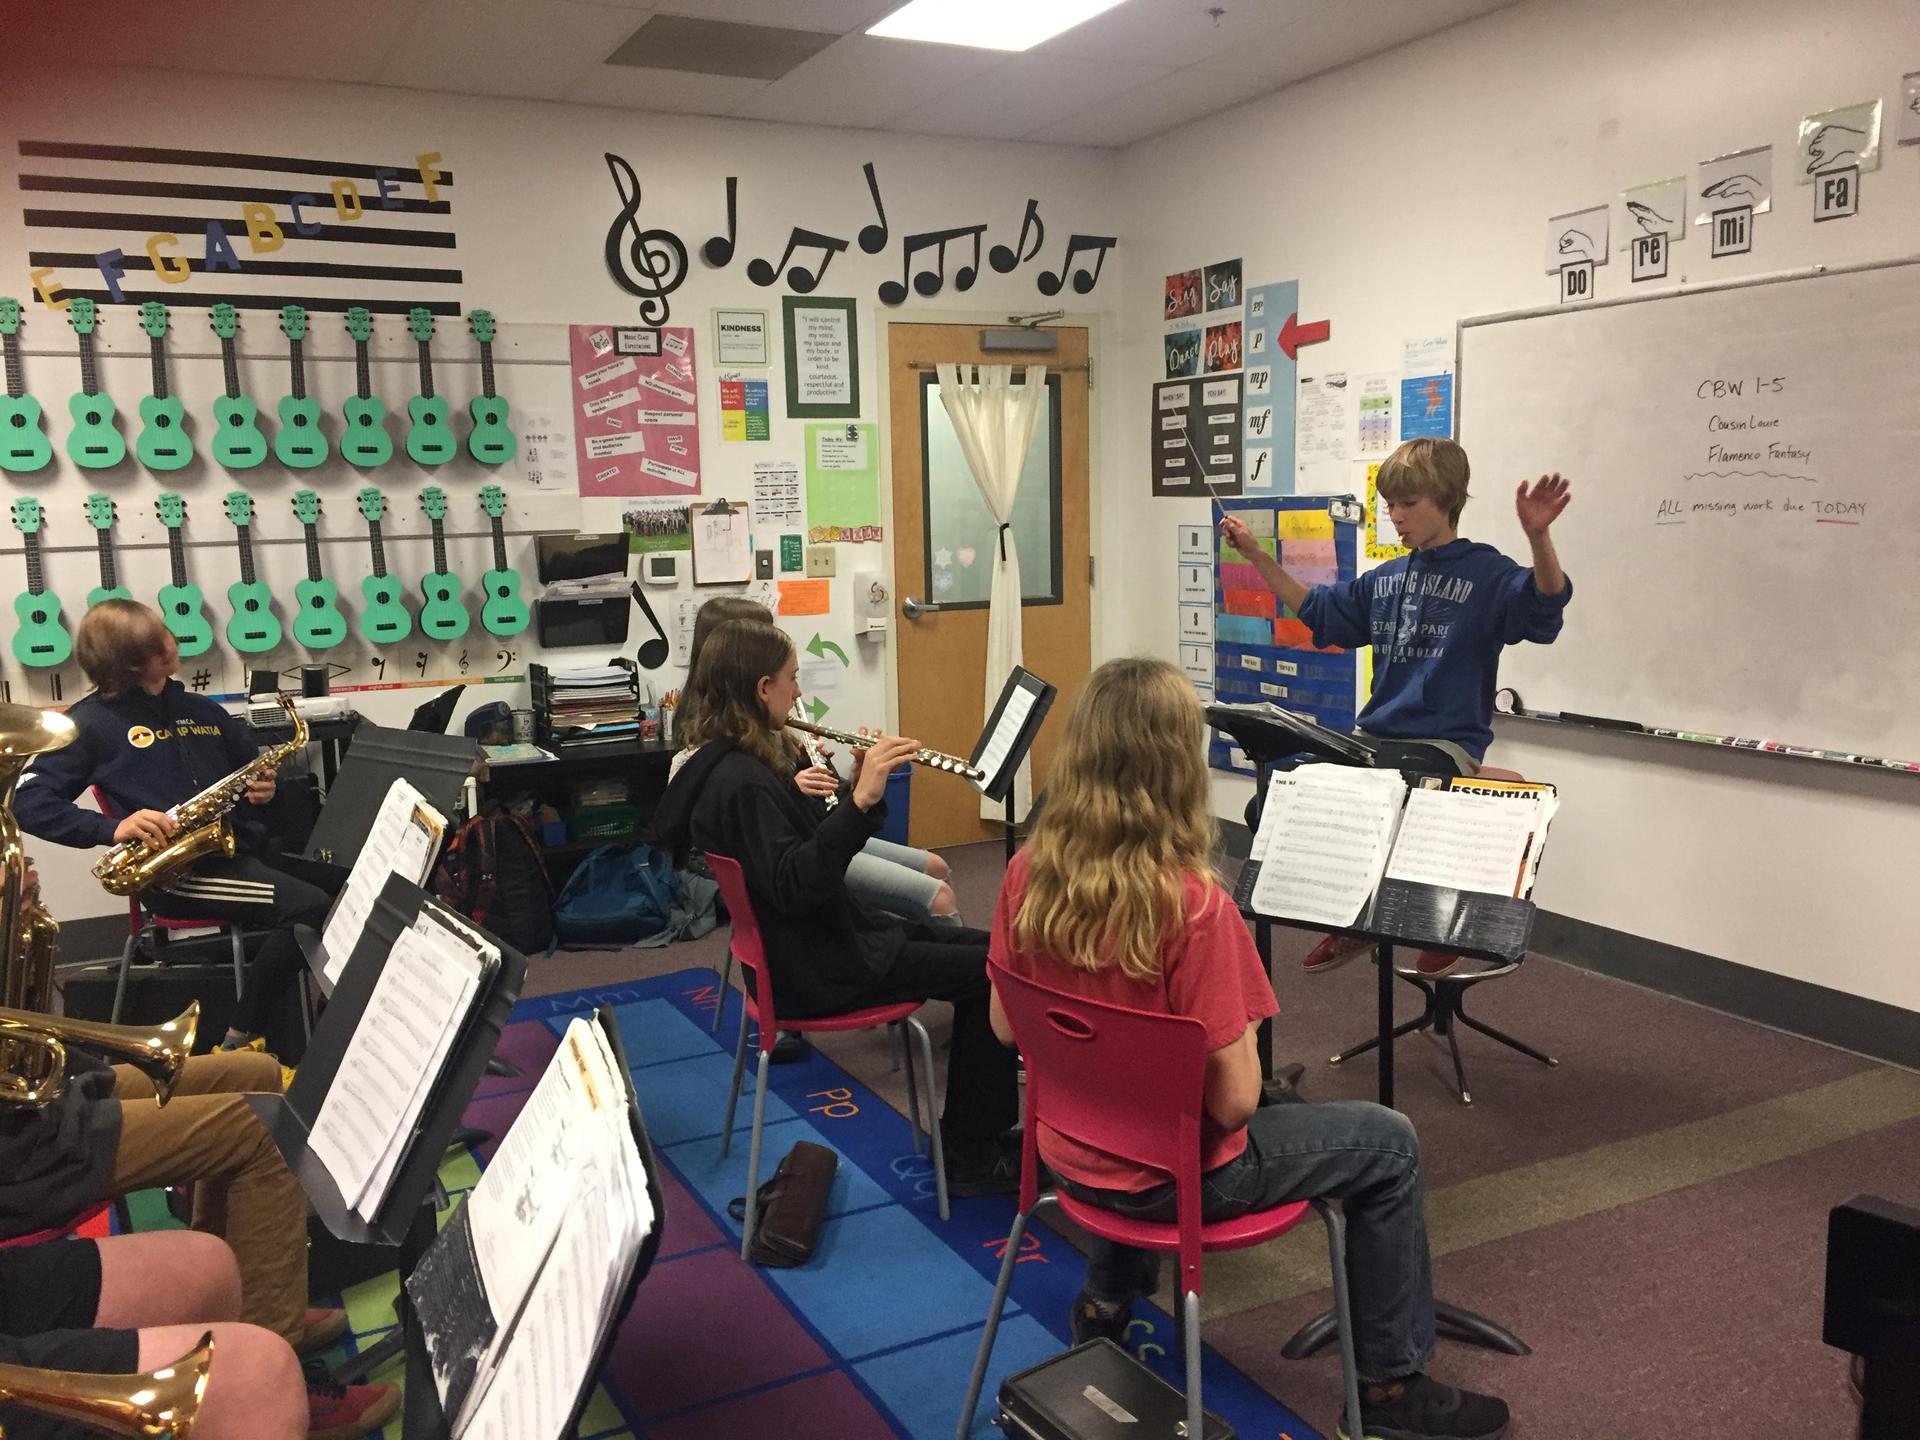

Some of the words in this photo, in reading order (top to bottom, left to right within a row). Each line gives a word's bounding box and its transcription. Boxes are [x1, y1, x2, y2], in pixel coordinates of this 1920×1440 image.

[30, 267, 70, 310] E
[95, 248, 126, 302] F
[145, 232, 191, 284] G
[204, 221, 241, 272] A
[242, 202, 285, 253] B
[290, 194, 322, 235] C
[330, 178, 364, 221] D
[374, 168, 403, 209] E
[415, 151, 443, 202] F
[1639, 236, 1661, 267] re
[1209, 273, 1238, 304] Say
[720, 324, 762, 333] KINDNESS
[1250, 371, 1269, 390] mp
[1697, 380, 1744, 400] CBW
[1249, 408, 1271, 435] mf
[1708, 414, 1748, 433] Cousin
[1708, 444, 1761, 462] Flamenco
[1767, 442, 1813, 464] Fantasy
[1250, 451, 1267, 481] f
[1656, 500, 1684, 518] ALL
[1692, 500, 1738, 517] missing
[1743, 499, 1774, 512] work
[1783, 498, 1806, 512] due
[1811, 500, 1869, 517] TODAY
[1371, 621, 1397, 632] STAT
[155, 726, 189, 741] CAP
